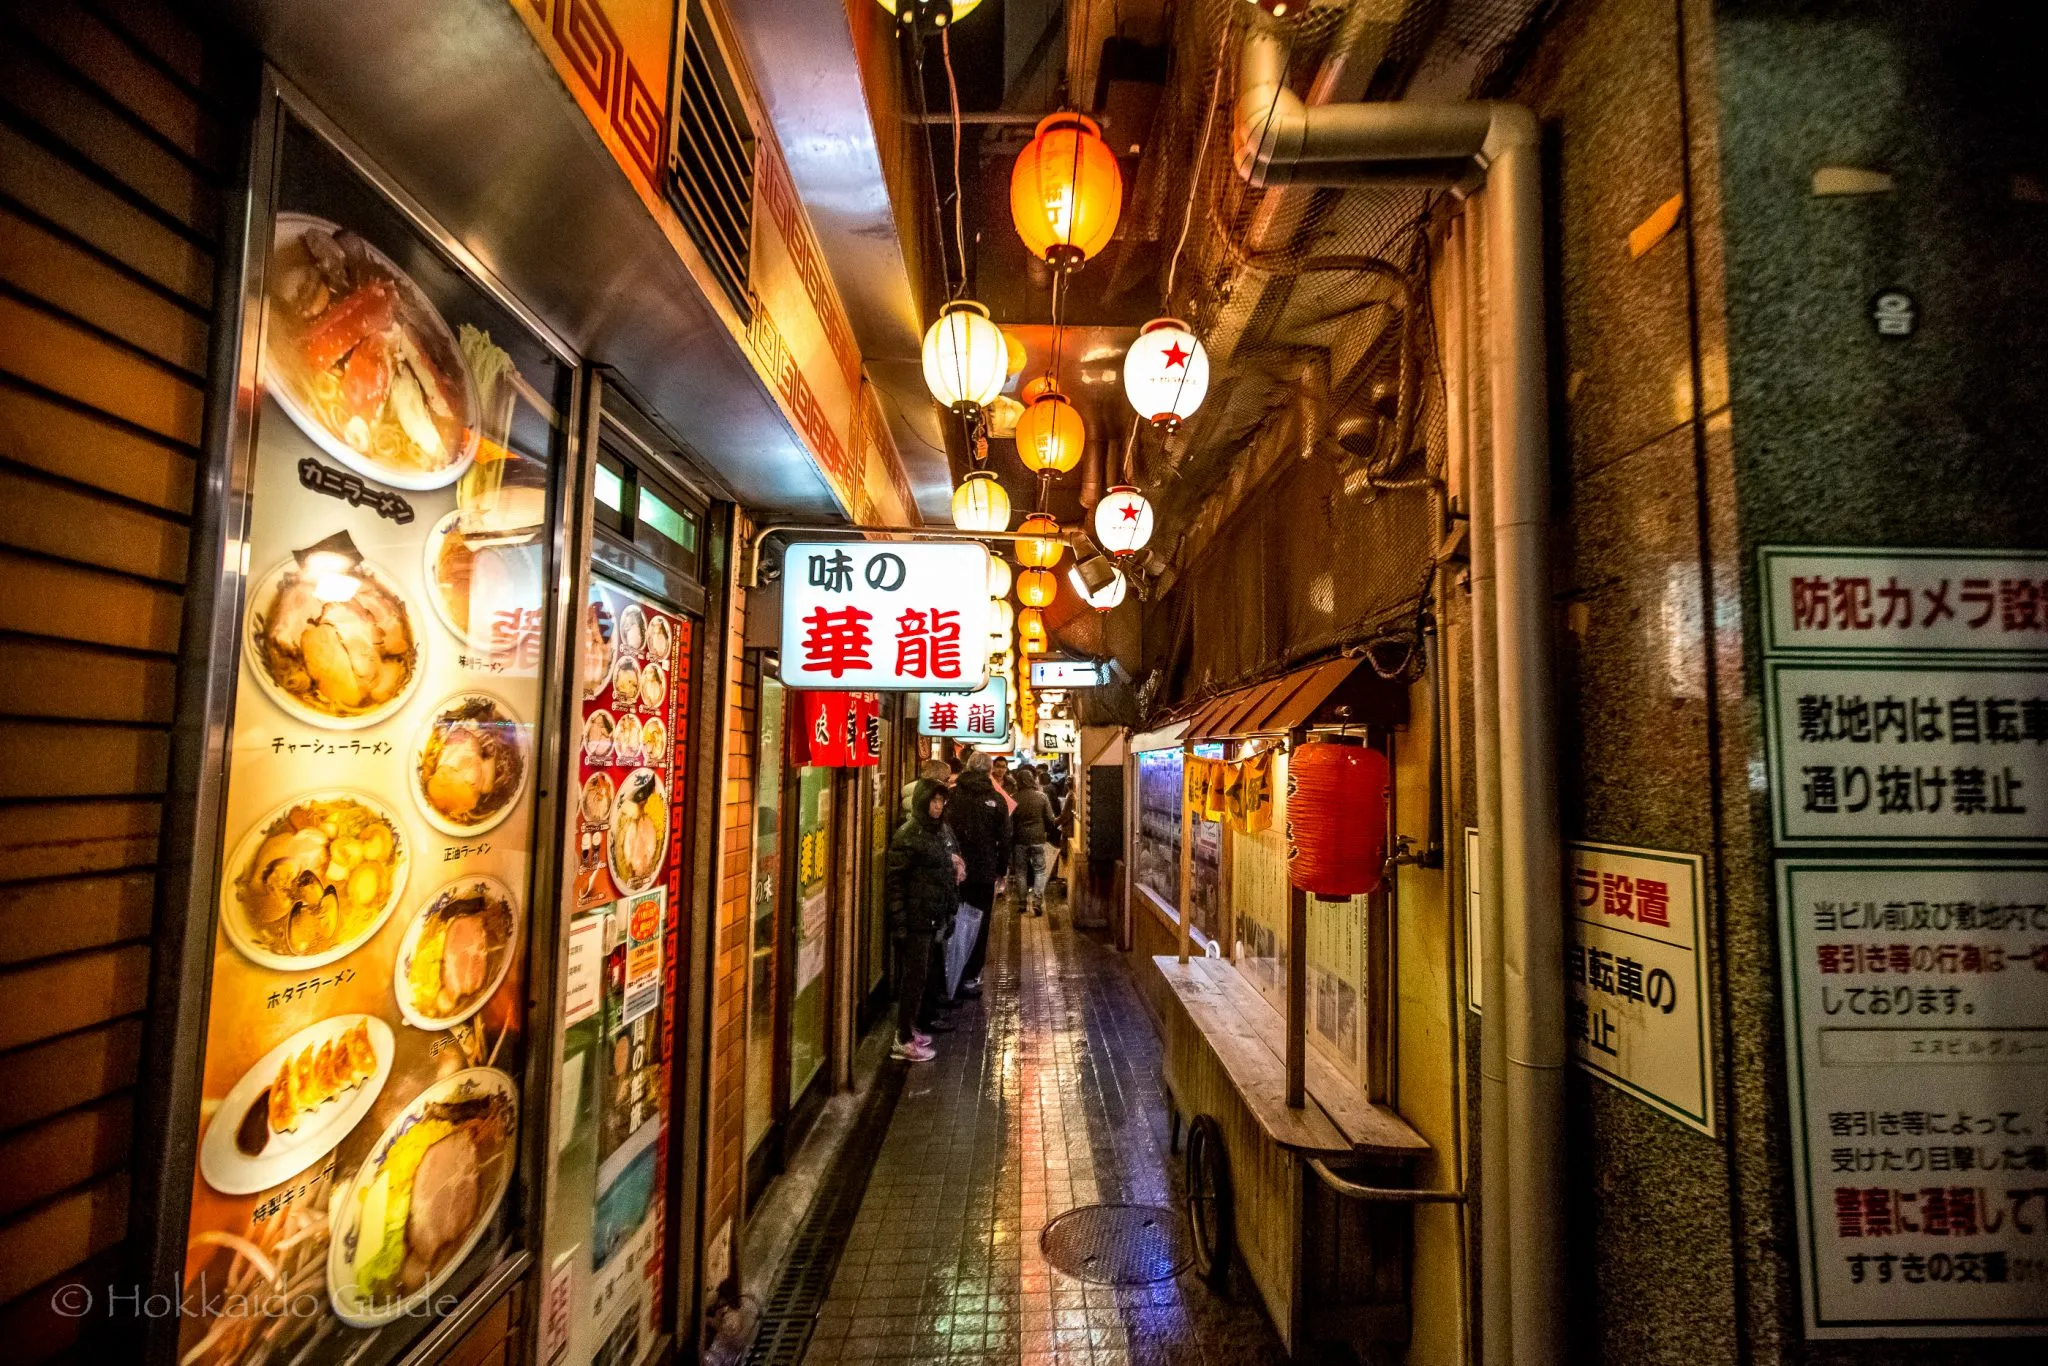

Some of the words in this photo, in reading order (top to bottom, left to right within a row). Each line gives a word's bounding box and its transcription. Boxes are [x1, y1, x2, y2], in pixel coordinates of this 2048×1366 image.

[301, 461, 412, 521] カニラーメン
[808, 548, 906, 593] 味の
[1790, 575, 2048, 633] 防犯カメラ設
[801, 605, 962, 680] 華龍
[928, 701, 996, 734] 華龍
[271, 736, 393, 756] チャーシューラーメン
[1802, 765, 2027, 816] 通り抜け禁止
[1574, 868, 1671, 928] ラ設置
[266, 968, 356, 1009] ホタテラーメン
[1822, 985, 1977, 1016] しております。
